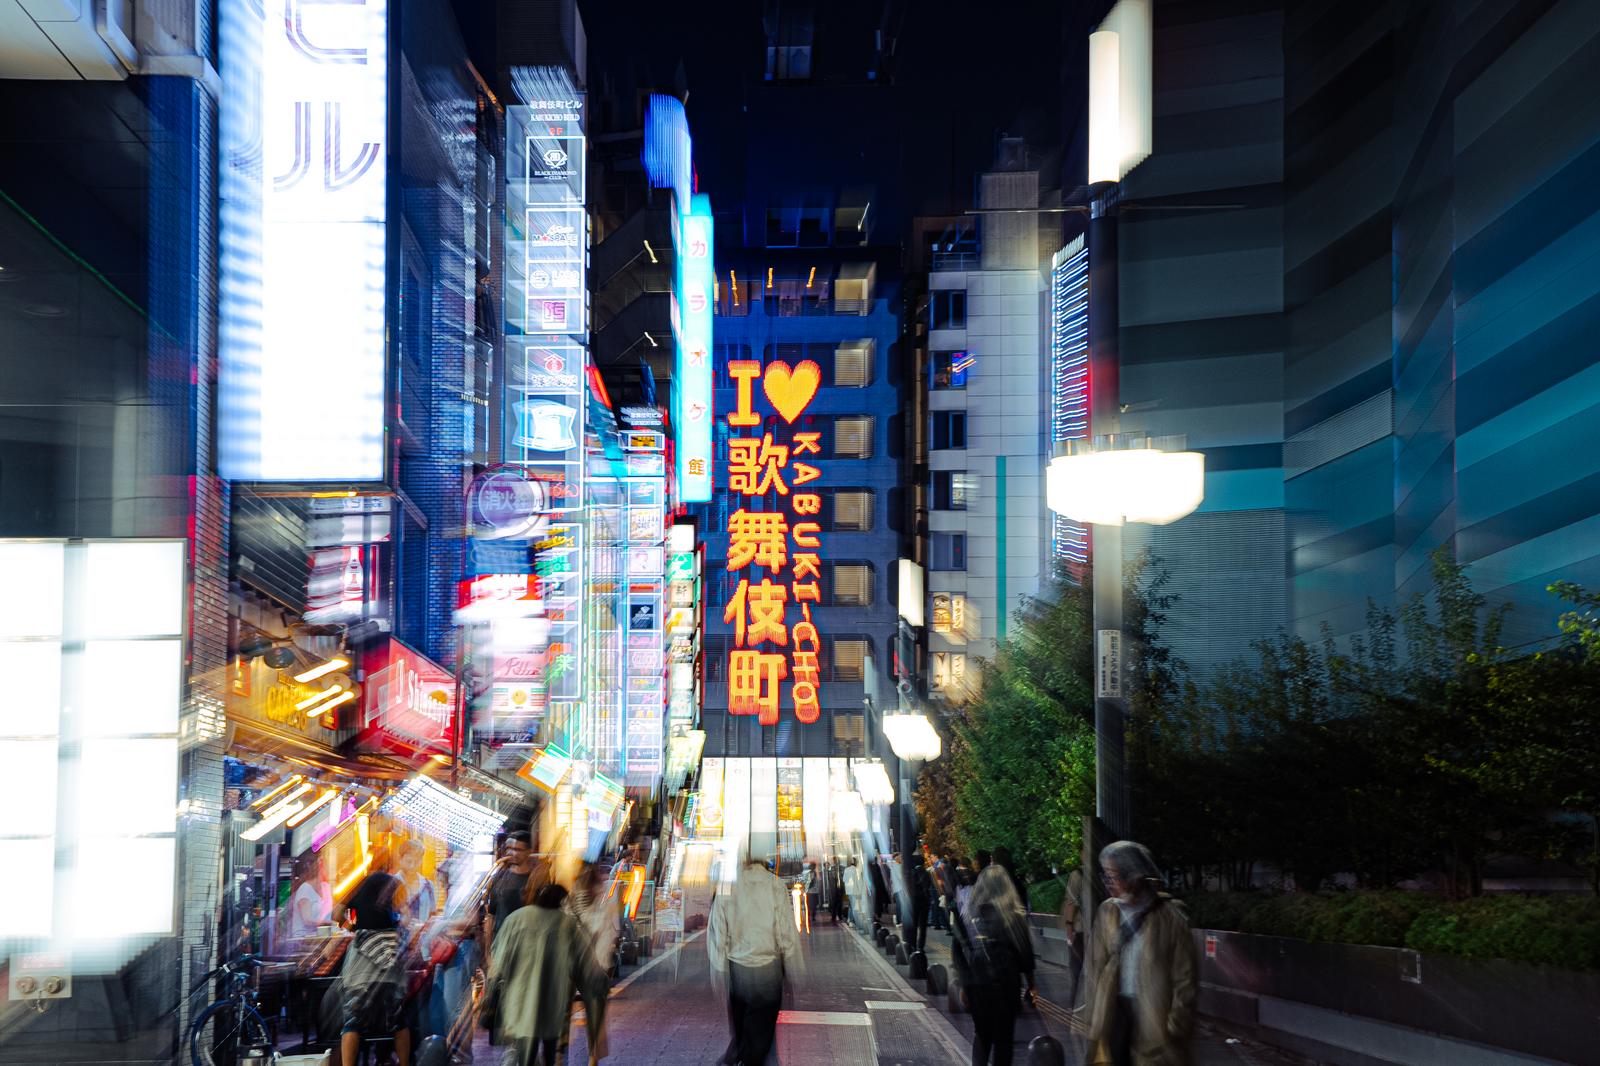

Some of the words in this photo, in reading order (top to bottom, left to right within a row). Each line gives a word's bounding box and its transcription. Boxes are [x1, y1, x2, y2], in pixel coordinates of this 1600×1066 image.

[688, 239, 708, 477] カラオケ館
[728, 360, 762, 426] I
[723, 431, 789, 726] 歌舞伎町
[792, 431, 822, 724] KABUKI-CHO
